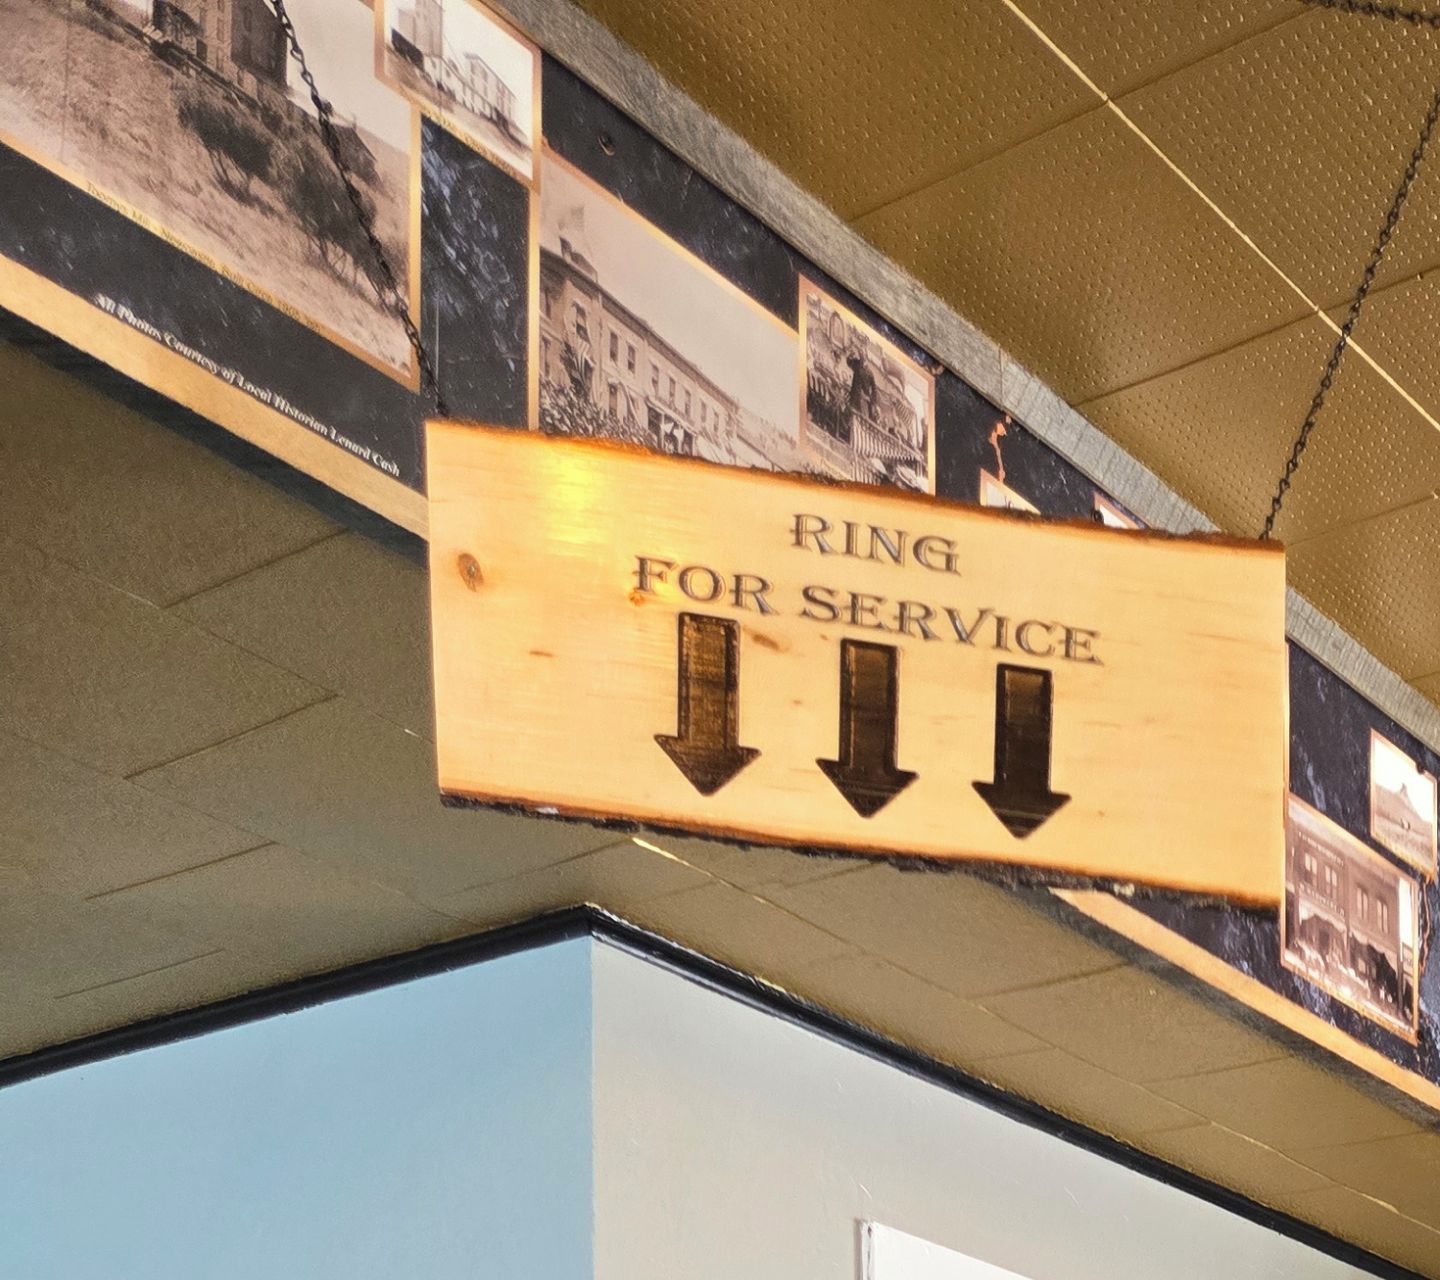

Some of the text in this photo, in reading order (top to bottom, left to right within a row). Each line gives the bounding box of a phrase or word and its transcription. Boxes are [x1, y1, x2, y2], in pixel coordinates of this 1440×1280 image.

[117, 302, 163, 341] Photos
[163, 329, 220, 374] Courtesy
[220, 366, 238, 385] of
[237, 371, 272, 403] Local
[273, 394, 328, 436] Historian
[371, 452, 400, 477] Cash
[790, 513, 962, 576] RING
[632, 555, 1104, 666] FOR SERVICE
